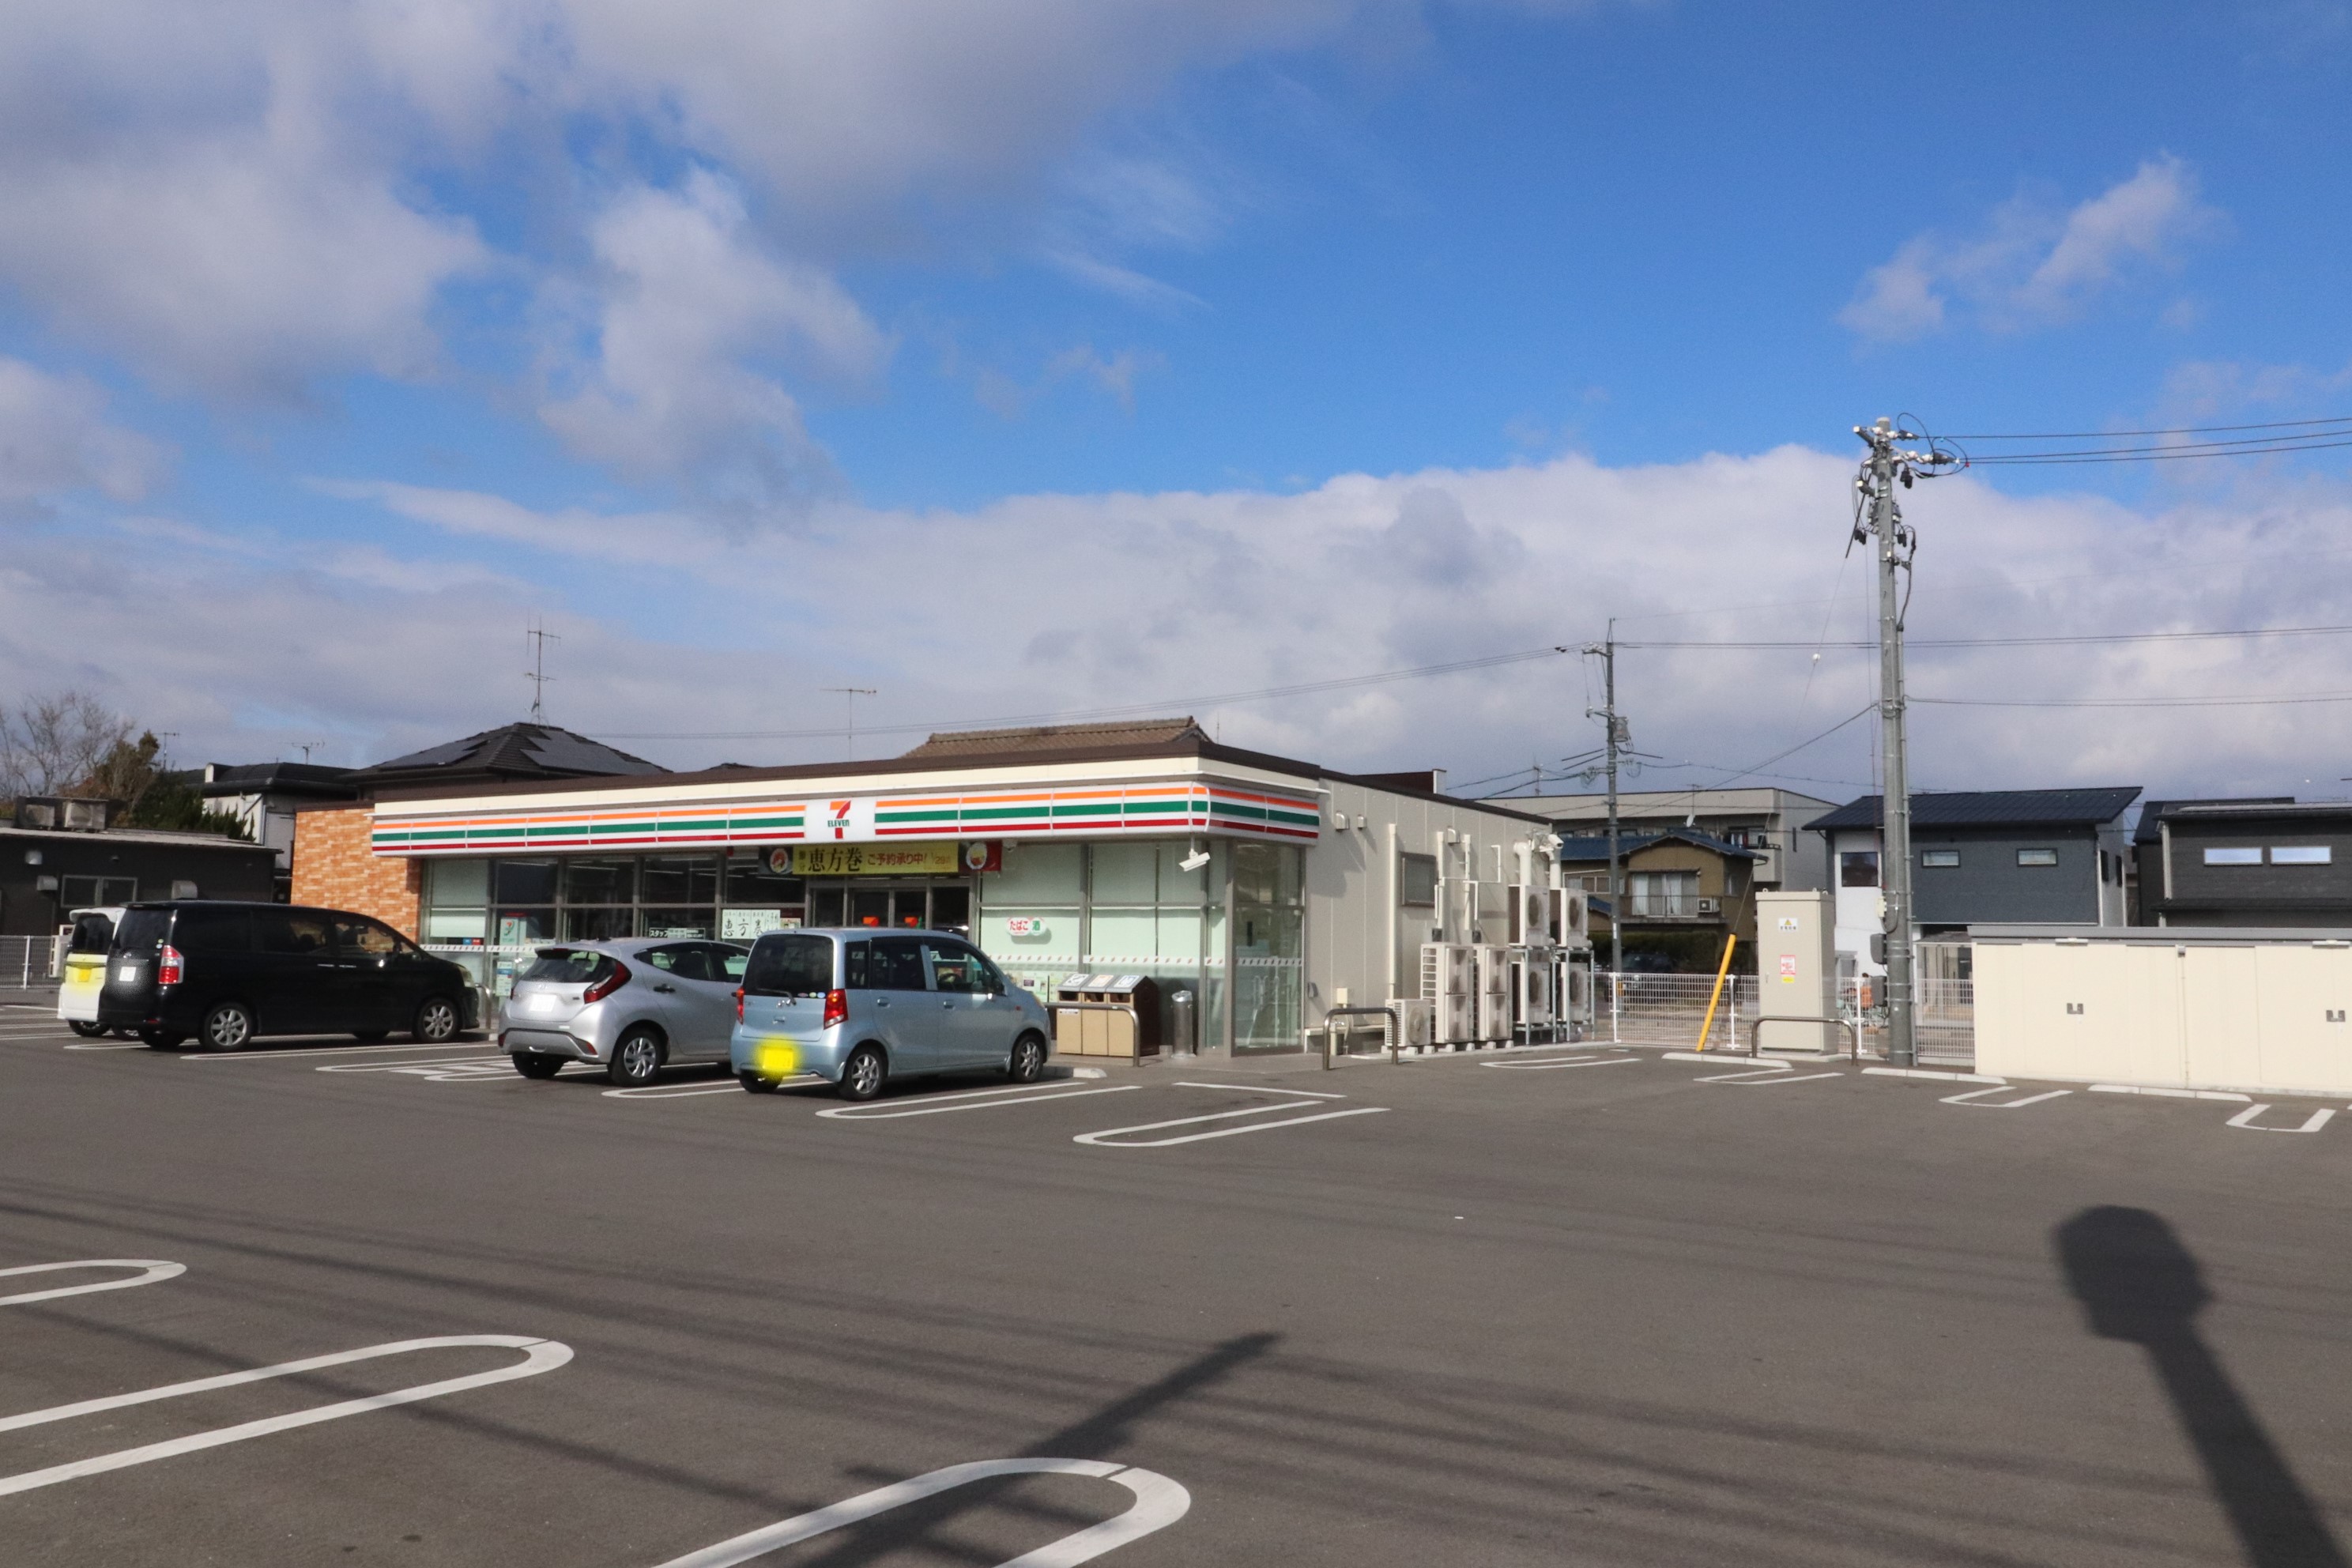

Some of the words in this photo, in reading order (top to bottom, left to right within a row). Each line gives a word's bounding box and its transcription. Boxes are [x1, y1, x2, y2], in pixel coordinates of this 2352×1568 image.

[808, 847, 862, 872] 恵方巻
[1010, 920, 1028, 931] たばこ
